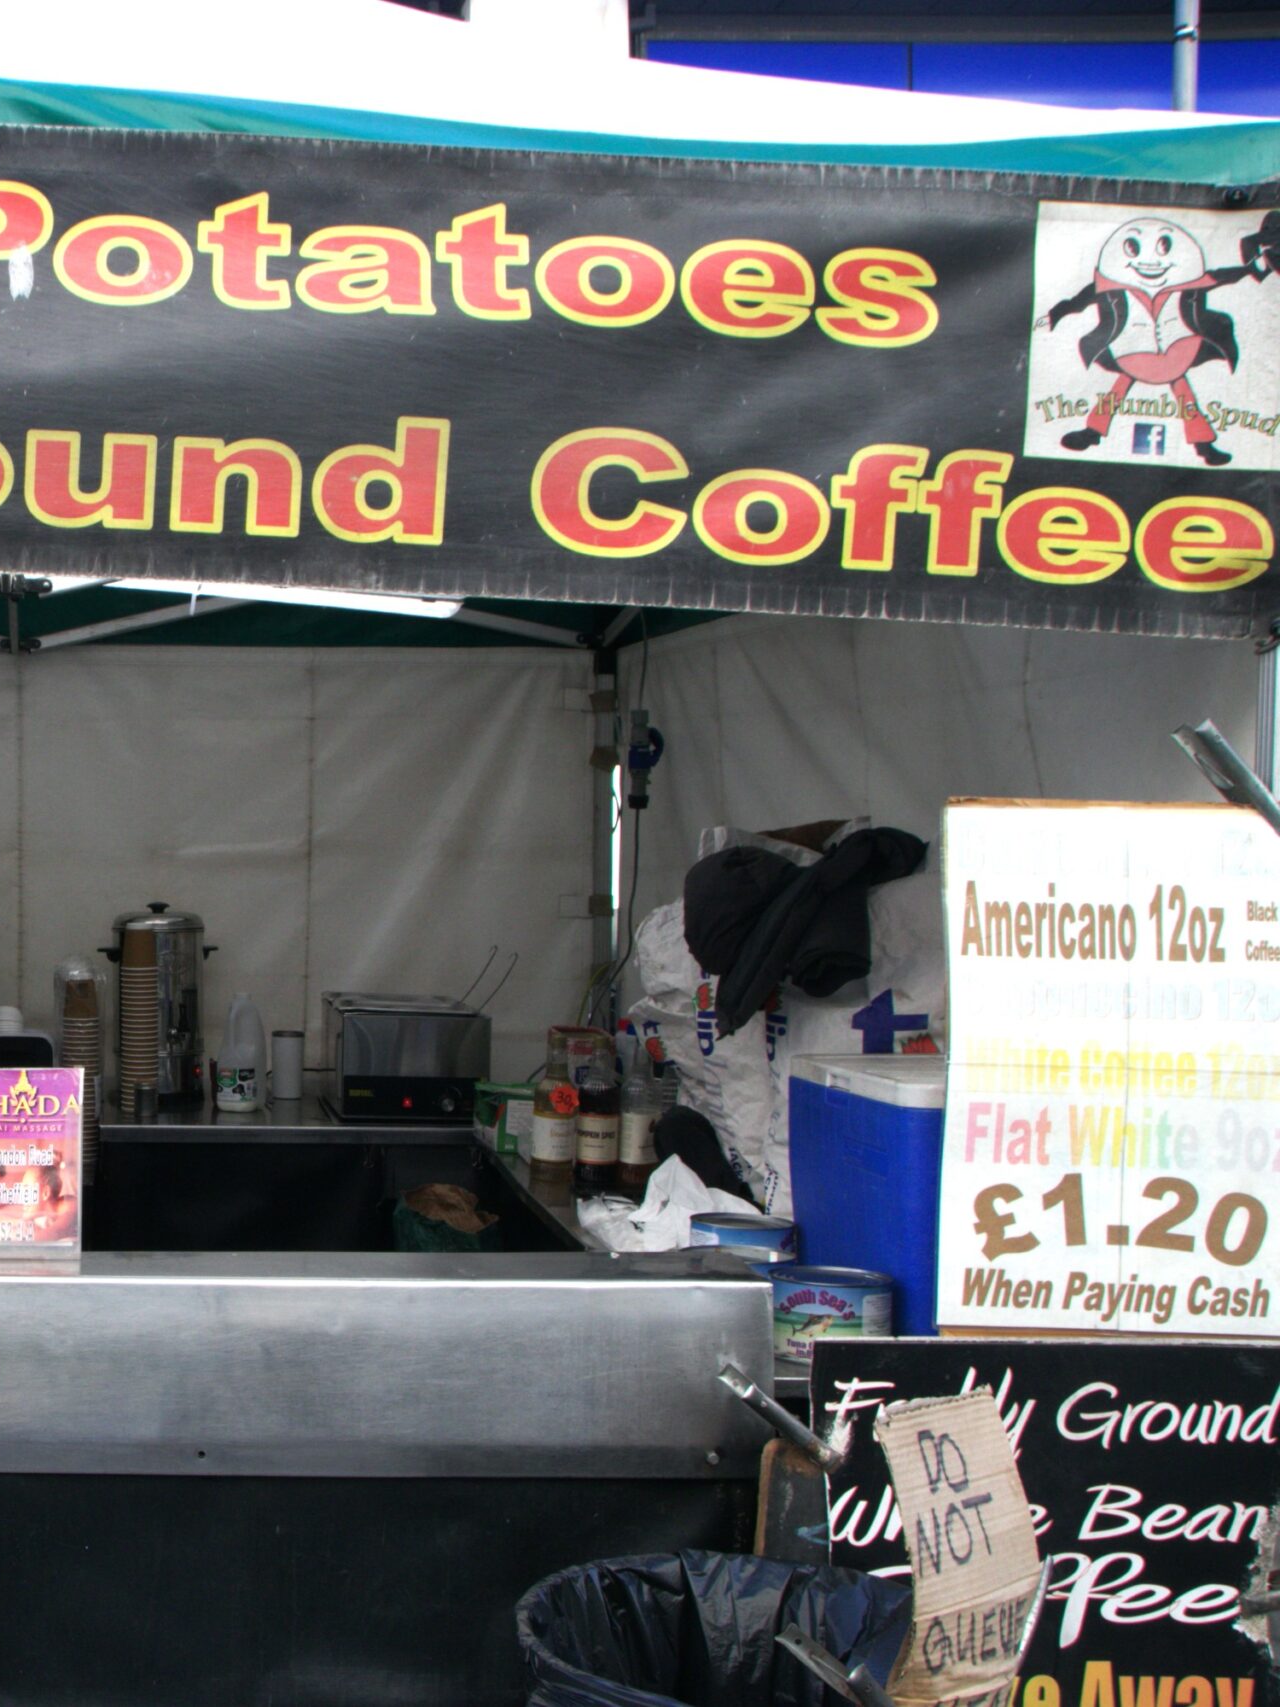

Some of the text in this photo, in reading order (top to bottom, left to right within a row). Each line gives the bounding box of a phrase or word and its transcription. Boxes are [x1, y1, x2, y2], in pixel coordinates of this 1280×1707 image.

[1035, 391, 1280, 436] The Humble Spud
[531, 427, 1275, 594] Coffee
[961, 880, 1225, 963] Americano 12oz
[1246, 900, 1278, 922] Black
[13, 1123, 62, 1132] MASSAGE
[964, 1102, 1052, 1166] Flat
[1068, 1104, 1199, 1169] White
[973, 1173, 1269, 1267] £1.20
[779, 1289, 816, 1315] South
[961, 1268, 1271, 1324] When Paying Cash
[1056, 1381, 1280, 1450] Ground
[917, 1429, 969, 1494] DO
[916, 1491, 993, 1579] NOT
